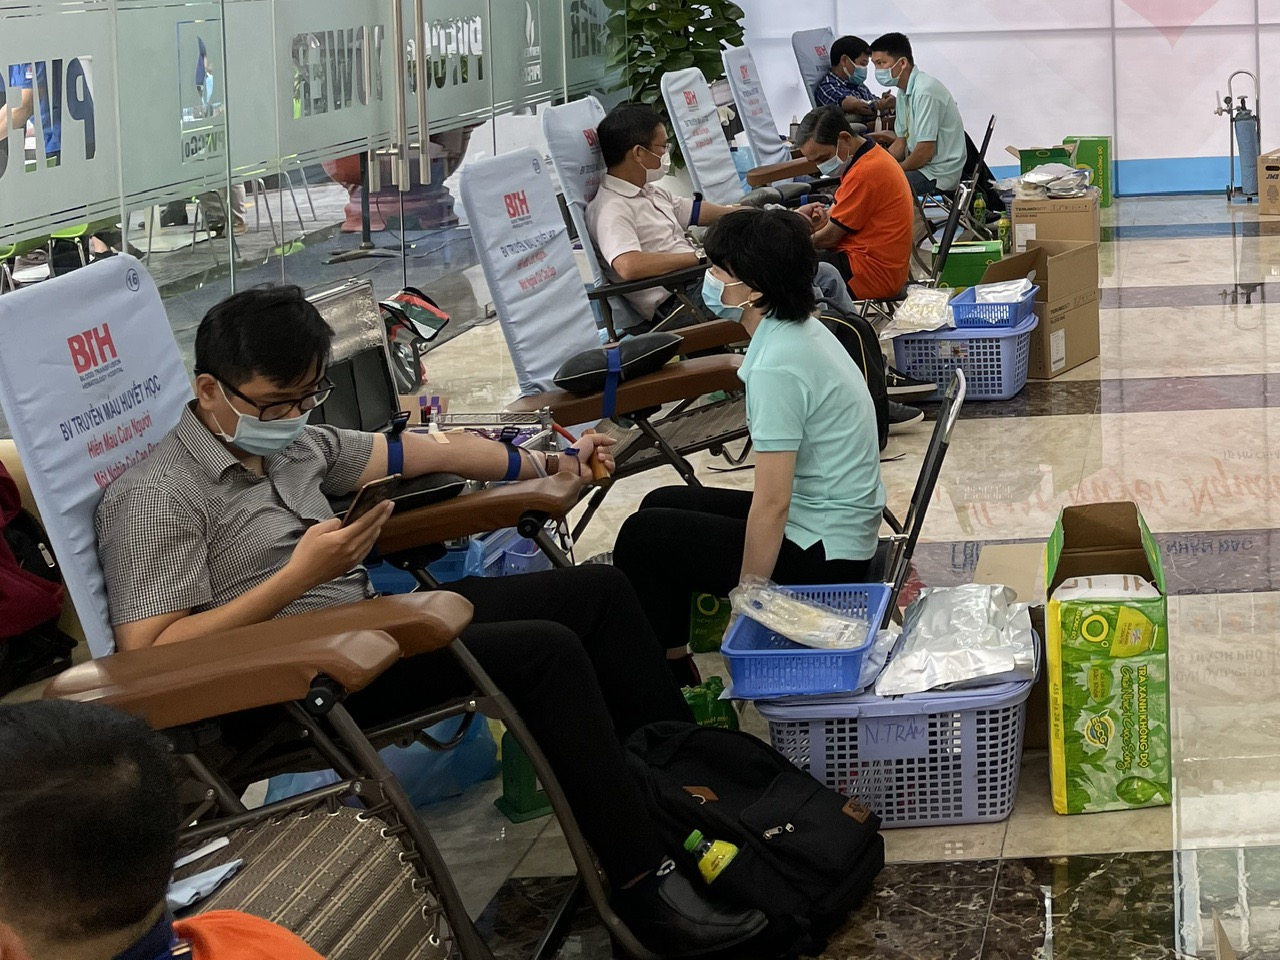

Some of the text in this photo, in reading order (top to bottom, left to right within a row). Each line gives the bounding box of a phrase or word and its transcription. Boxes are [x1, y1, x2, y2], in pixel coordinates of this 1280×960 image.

[504, 190, 530, 219] BTH
[127, 273, 138, 287] 16
[67, 322, 118, 374] BTH
[79, 371, 95, 382] BLOOD
[59, 375, 162, 441] BV TRUYỀN MÁU HUYẾT HỌC
[1052, 683, 1060, 695] 455
[1120, 690, 1134, 718] Nhiệt
[1138, 665, 1150, 768] TRÀ XANH KHÔNG ĐỘ
[1091, 717, 1108, 744] EGCG
[1120, 718, 1135, 744] Cuộc
[1116, 743, 1136, 774] Sống
